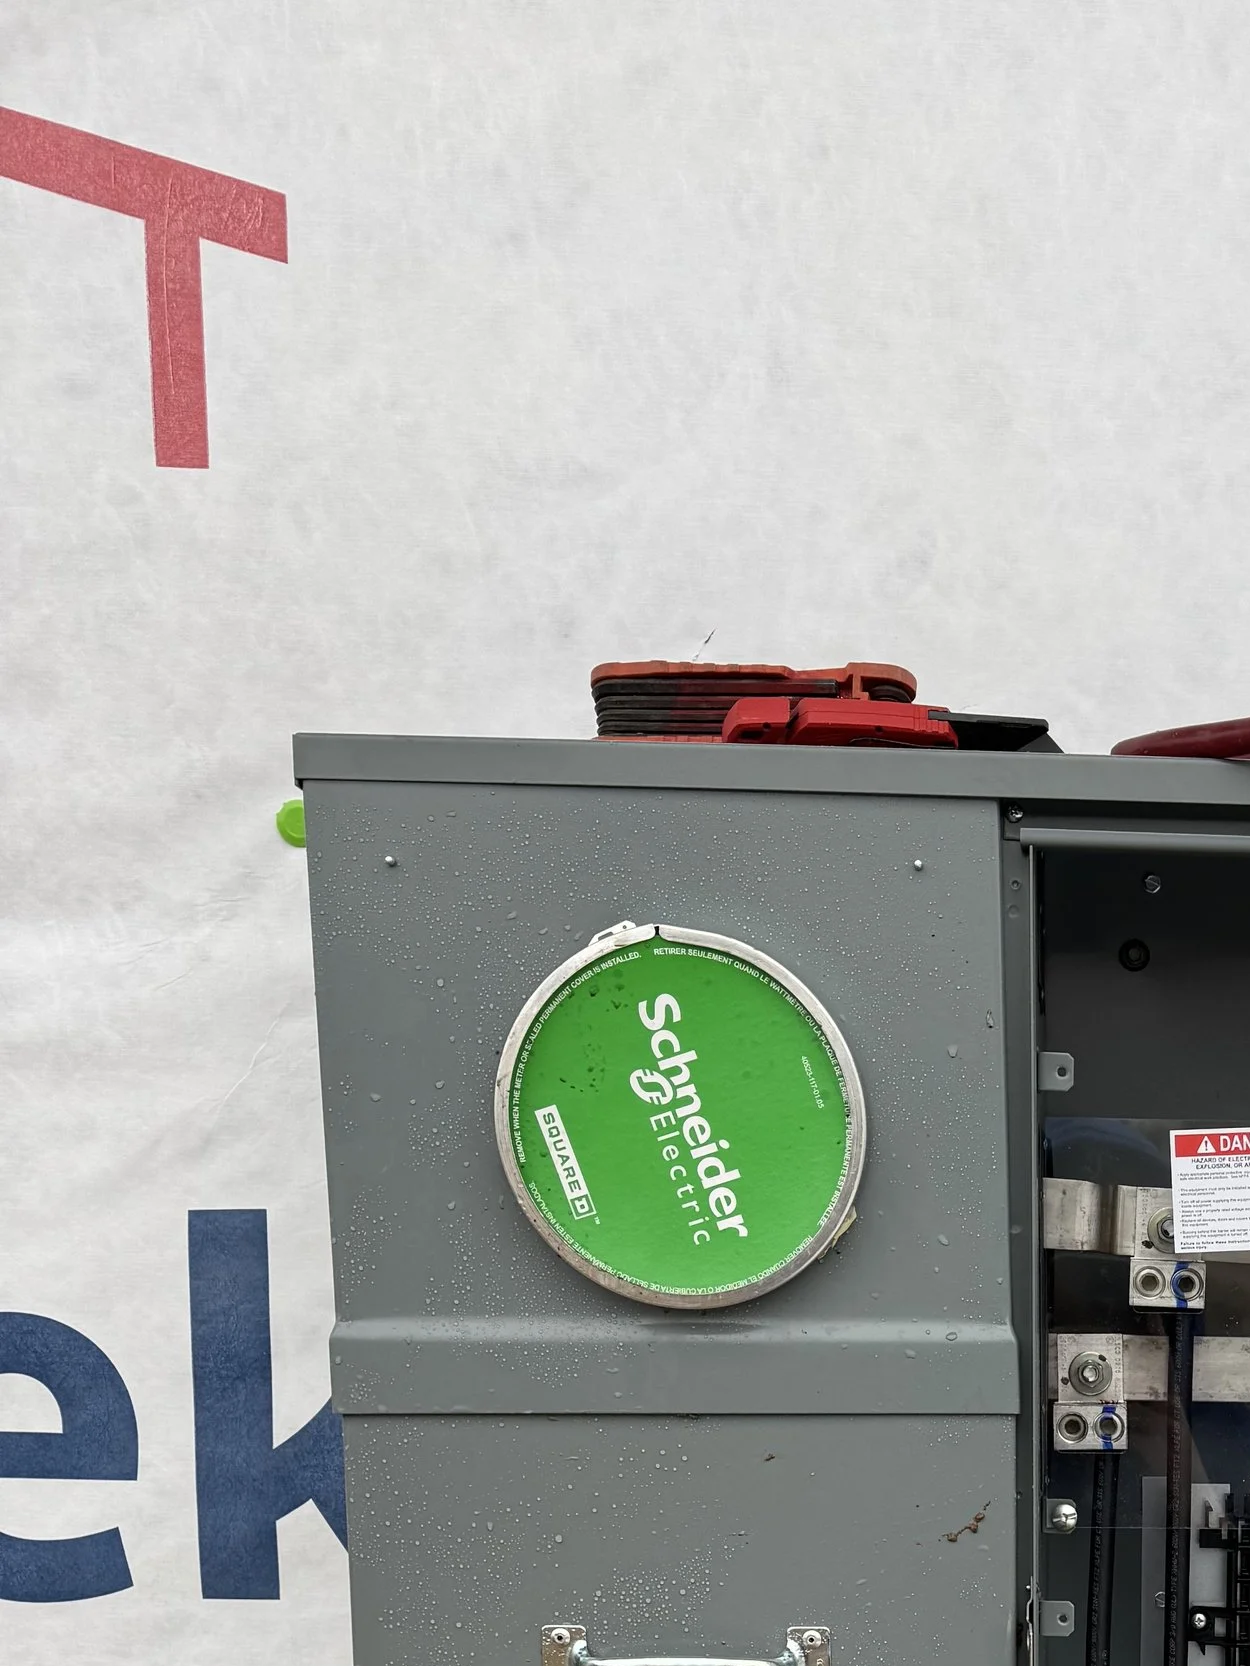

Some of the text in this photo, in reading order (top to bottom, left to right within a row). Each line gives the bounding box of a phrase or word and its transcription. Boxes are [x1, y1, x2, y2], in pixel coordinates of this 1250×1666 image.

[600, 951, 642, 972] INSTALLED.
[653, 947, 687, 956] RETIRER
[687, 949, 733, 966] SEULEMENT
[733, 961, 760, 978] QUAND
[759, 974, 770, 985] LE
[570, 970, 594, 989] COVER
[540, 985, 572, 1024] PERMANENT
[520, 1051, 530, 1063] OR
[515, 1063, 525, 1089] METER
[513, 1089, 521, 1105] THE
[512, 1105, 520, 1128] WHEN
[638, 993, 748, 1238] Schneider
[513, 1127, 526, 1163] REMOVE
[543, 1112, 582, 1193] SQUARE
[649, 1110, 711, 1245] Electric
